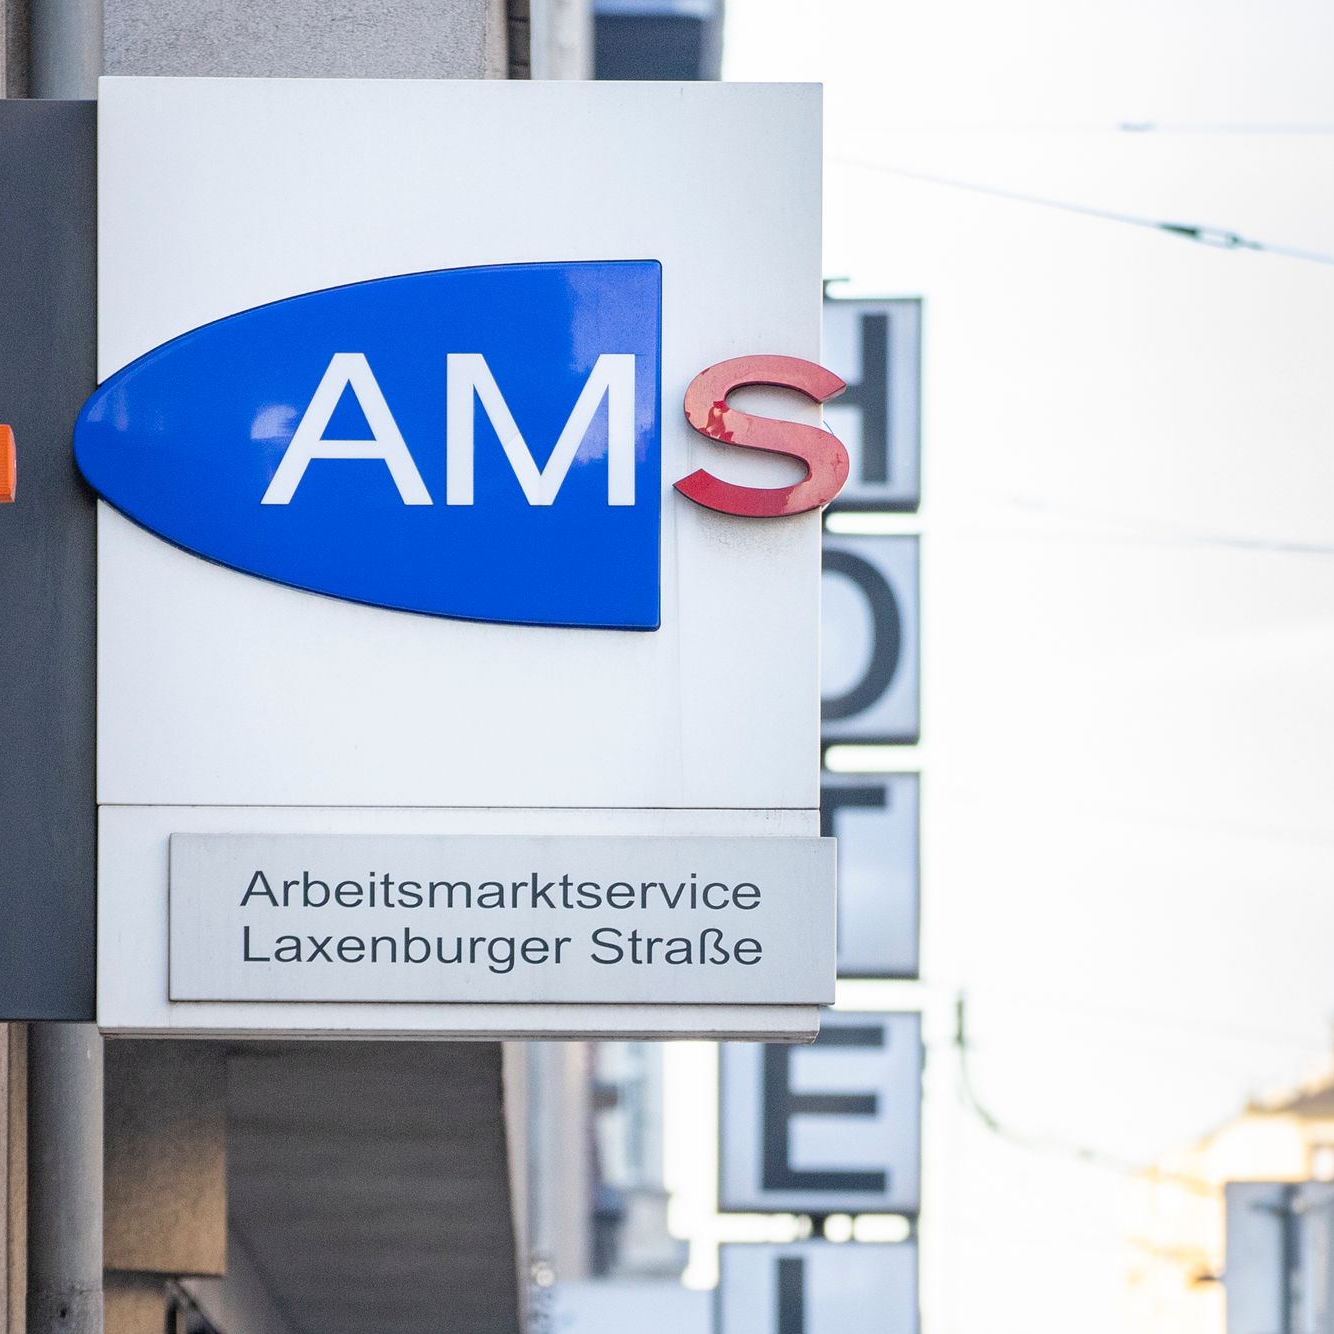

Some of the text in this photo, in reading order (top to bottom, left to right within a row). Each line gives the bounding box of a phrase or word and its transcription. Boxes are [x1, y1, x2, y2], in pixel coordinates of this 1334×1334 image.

[261, 352, 850, 519] AMS
[240, 871, 761, 910] Arbeitsmarktservice
[244, 926, 762, 974] Laxenburger Straße
